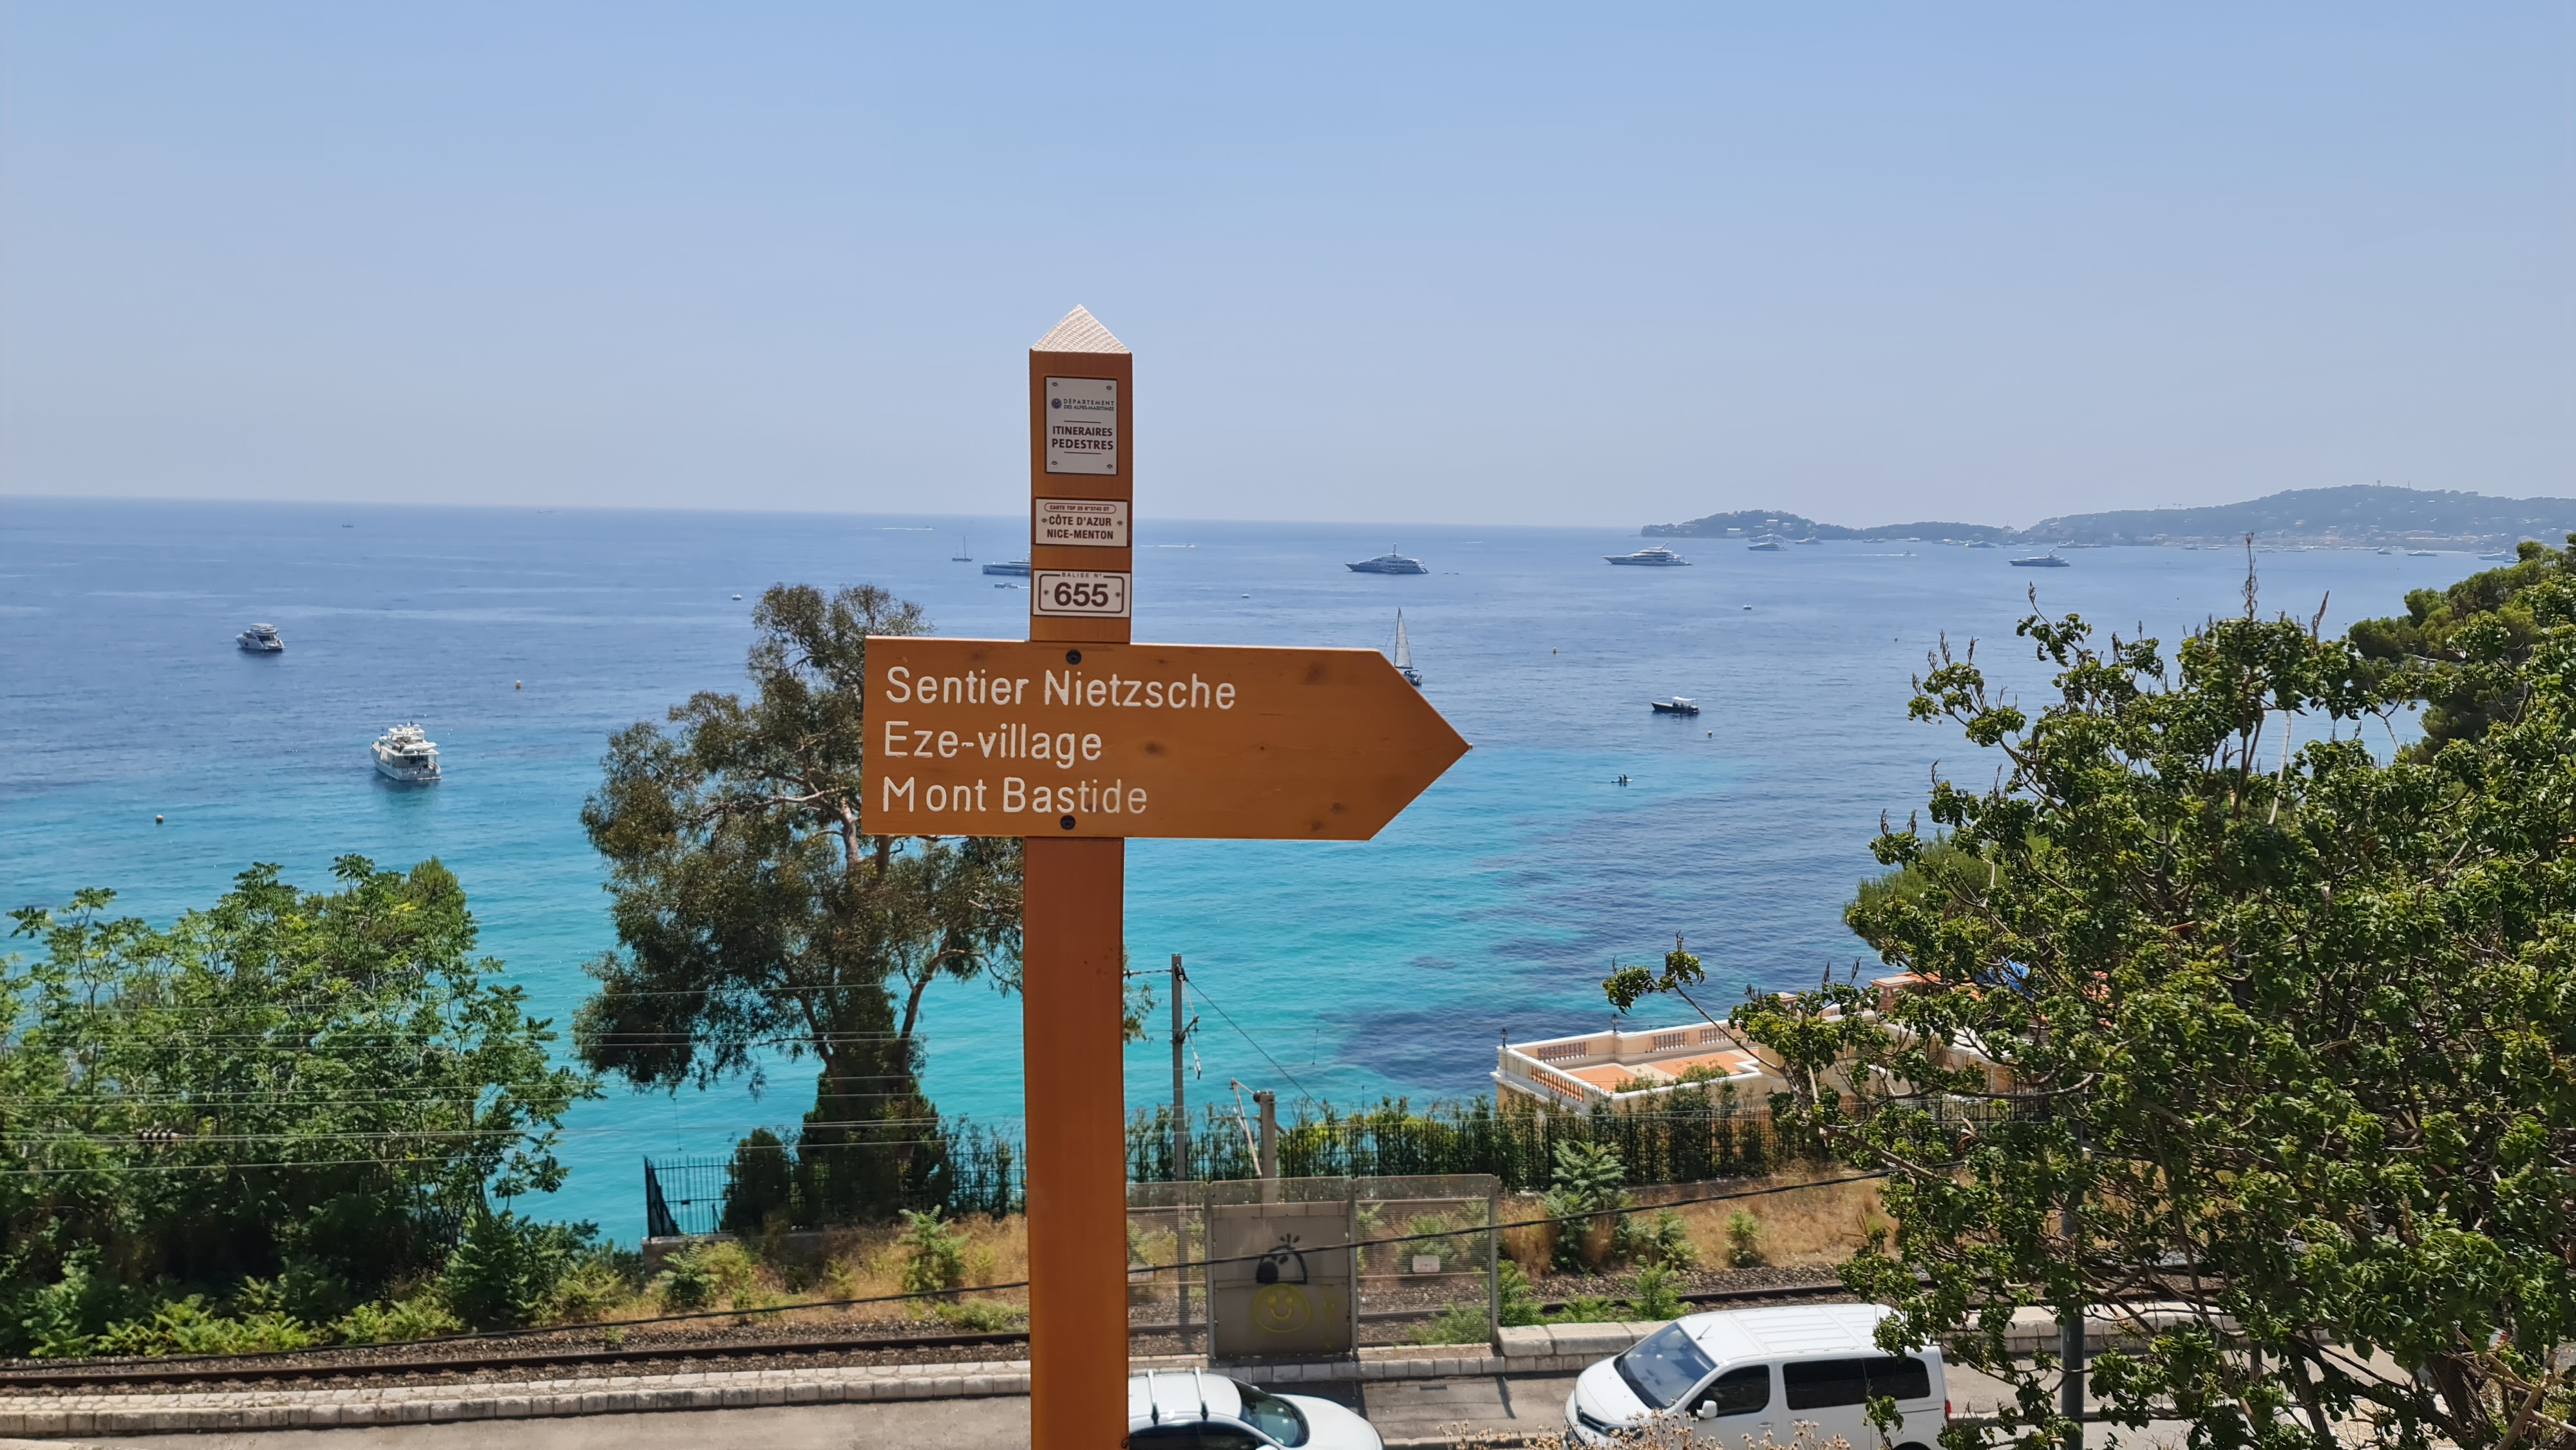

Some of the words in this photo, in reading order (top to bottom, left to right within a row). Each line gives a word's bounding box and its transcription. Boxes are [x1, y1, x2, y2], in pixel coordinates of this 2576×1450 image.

[1052, 426, 1113, 437] ITINERAIRES
[1052, 438, 1113, 450] PEDESTRES
[1048, 514, 1074, 525] CÔTE
[1077, 516, 1112, 526] D'AZUR
[1046, 529, 1113, 540] NICE-MENTON
[1054, 582, 1109, 607] 655
[886, 666, 1029, 705] Sentier
[1045, 670, 1236, 710] Nietzsche
[884, 720, 1103, 769] Eze-village
[883, 777, 987, 813] Mont
[1003, 777, 1148, 814] Bastide
